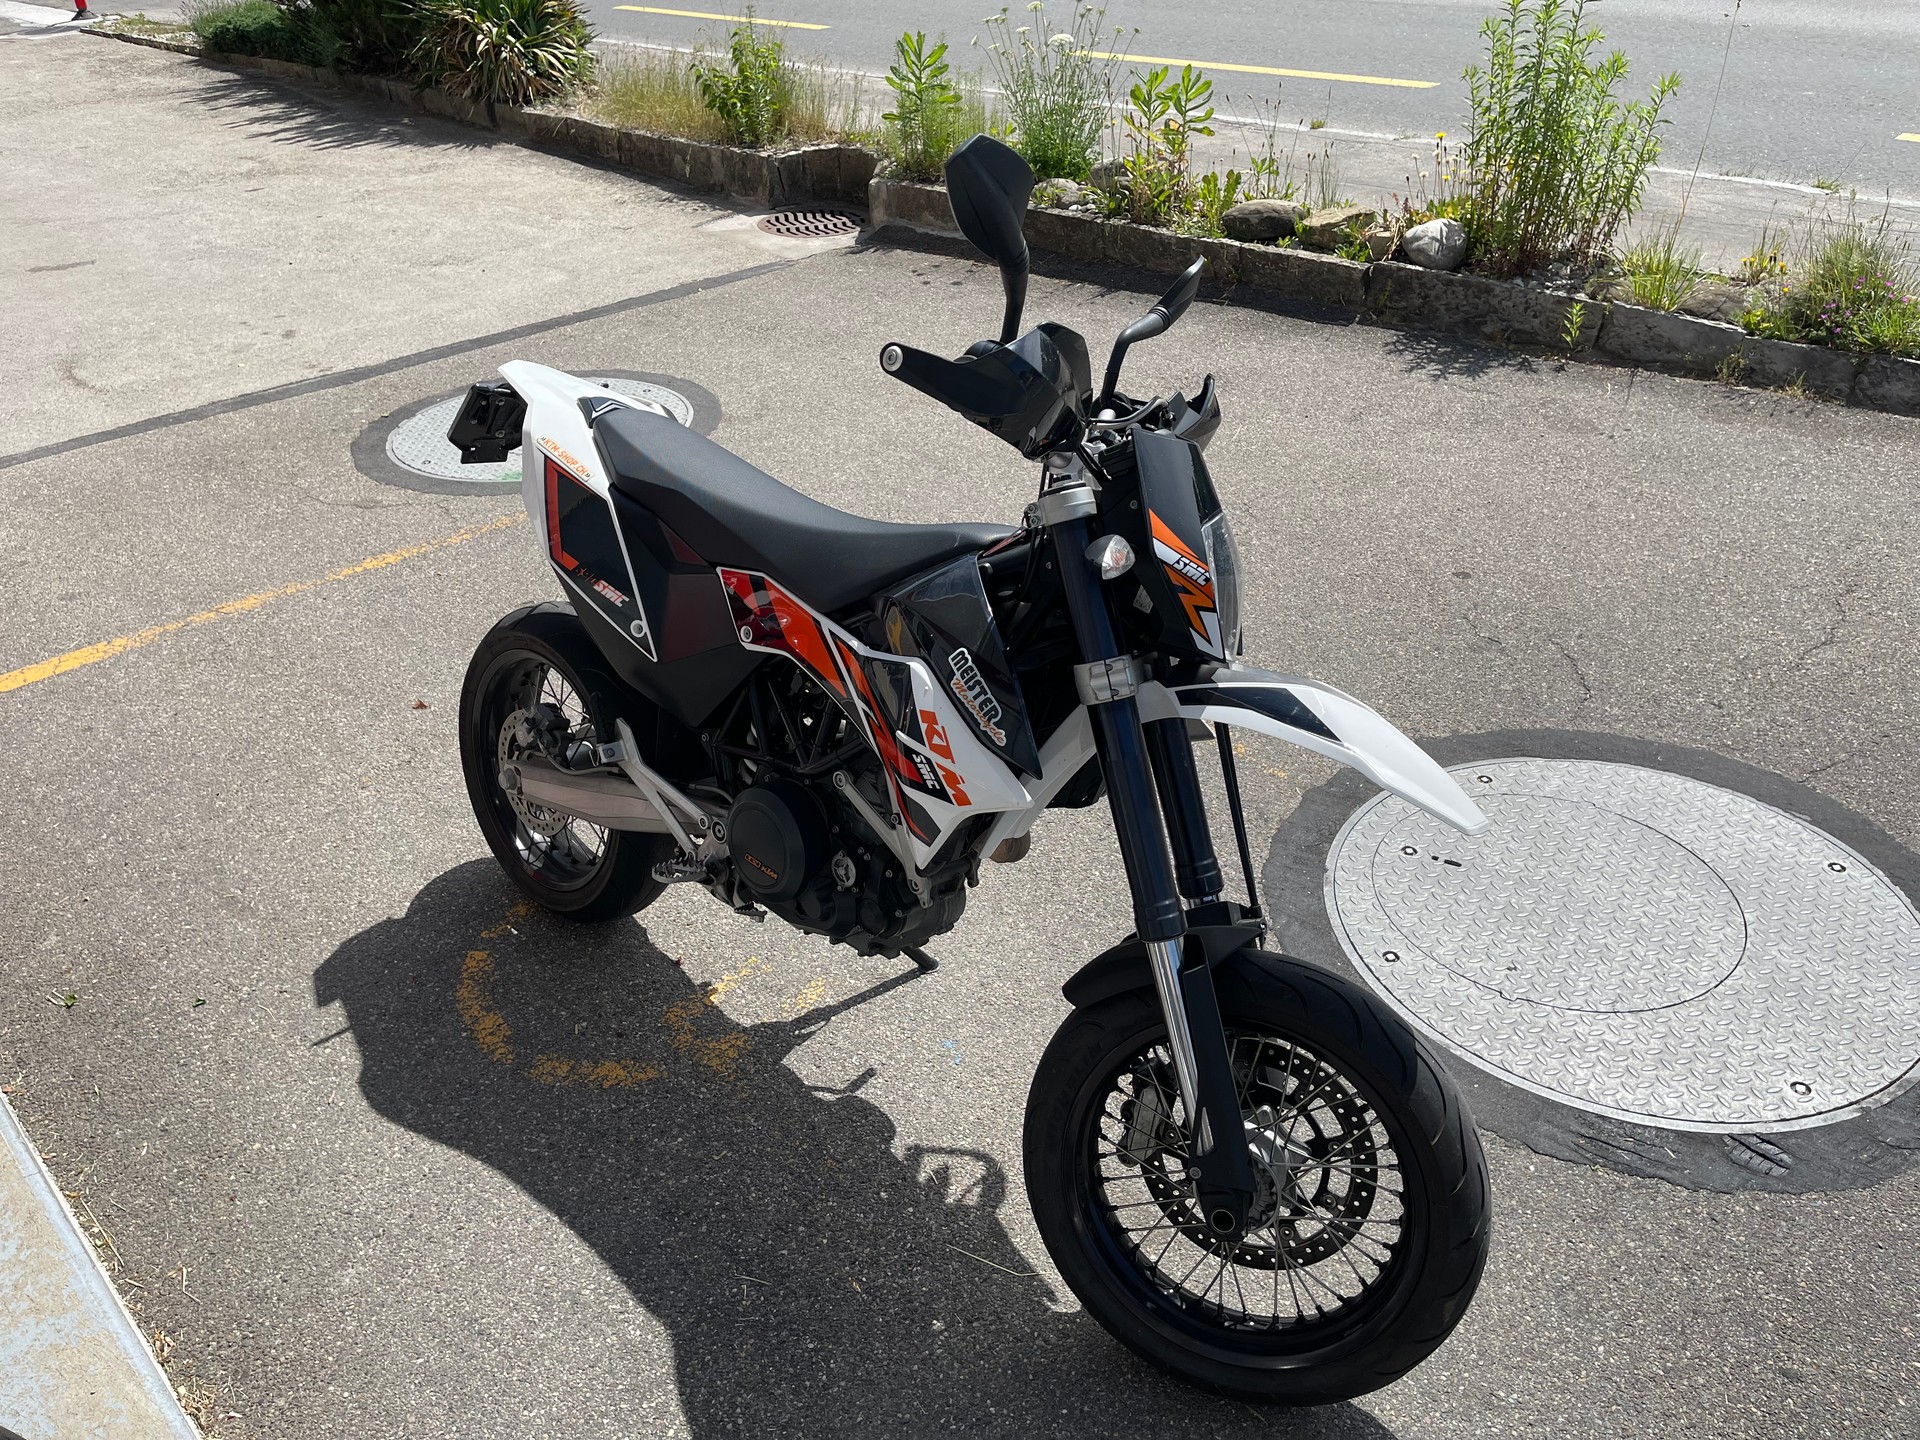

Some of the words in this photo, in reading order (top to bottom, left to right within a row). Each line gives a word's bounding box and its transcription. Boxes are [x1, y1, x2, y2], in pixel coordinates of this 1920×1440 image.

[593, 579, 630, 607] SMC
[1172, 556, 1210, 586] SMC
[951, 650, 1000, 724] MEISTER
[952, 677, 1005, 745] Motorcycle
[912, 754, 940, 789] SMC
[919, 709, 972, 807] KTM
